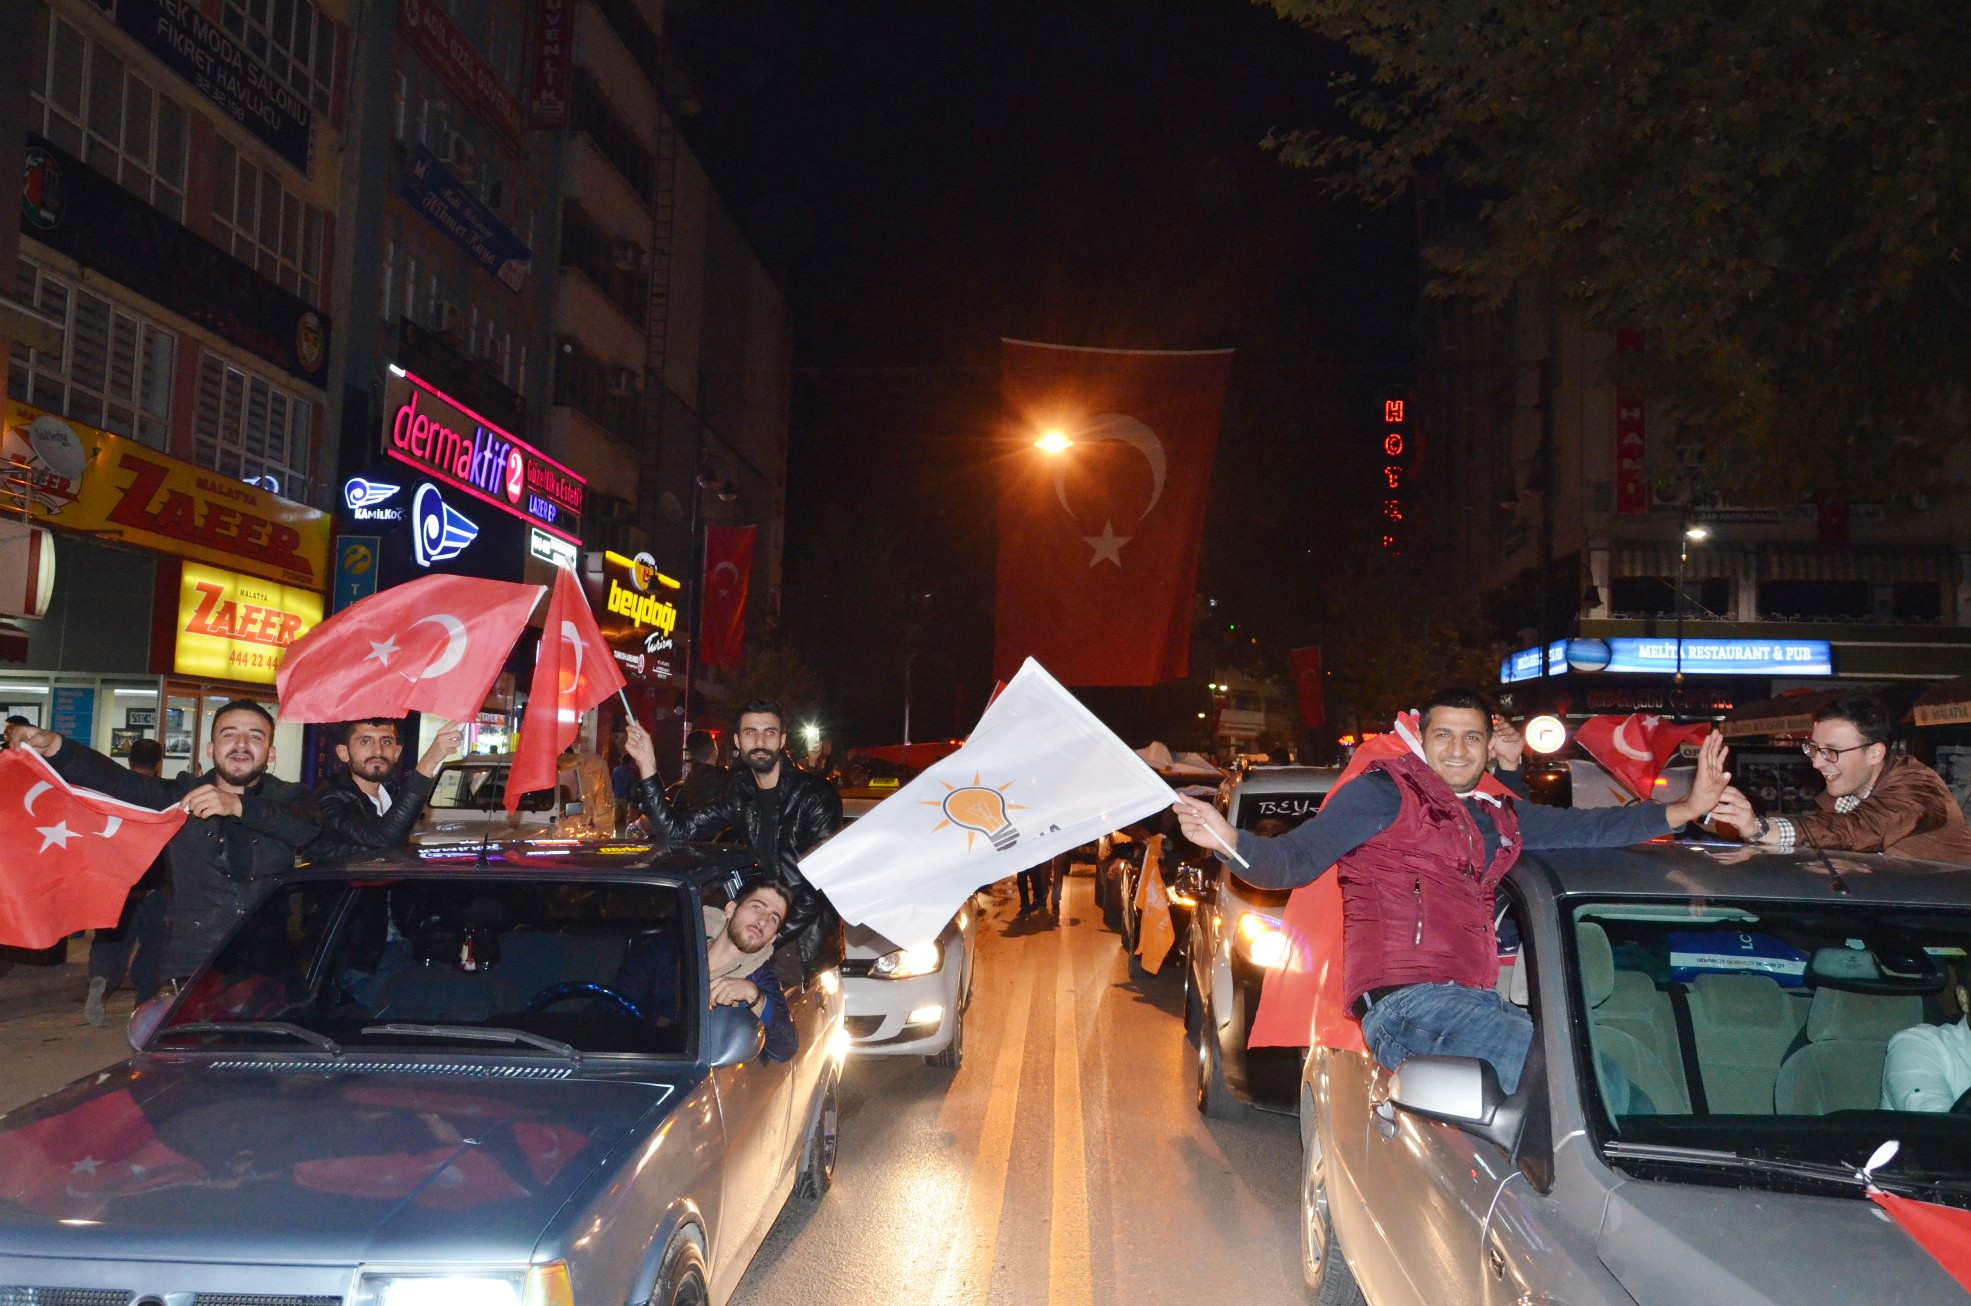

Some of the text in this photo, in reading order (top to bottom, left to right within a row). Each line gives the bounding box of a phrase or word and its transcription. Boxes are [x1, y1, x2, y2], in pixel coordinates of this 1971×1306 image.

[193, 16, 242, 73] MODA
[248, 63, 308, 127] SALONU
[393, 390, 511, 495] dermaktif
[196, 477, 258, 507] MALATYA
[527, 459, 556, 494] Güzellik
[1385, 400, 1403, 557] HOTE
[105, 453, 315, 579] ZAFER
[529, 494, 548, 520] LAZER
[185, 581, 303, 649] ZAFER
[240, 588, 268, 602] MALATYA
[607, 579, 677, 637] beydağı
[229, 649, 278, 671] 444 22 44
[1639, 642, 1812, 661] MELİTA RESTAURANT & PUB
